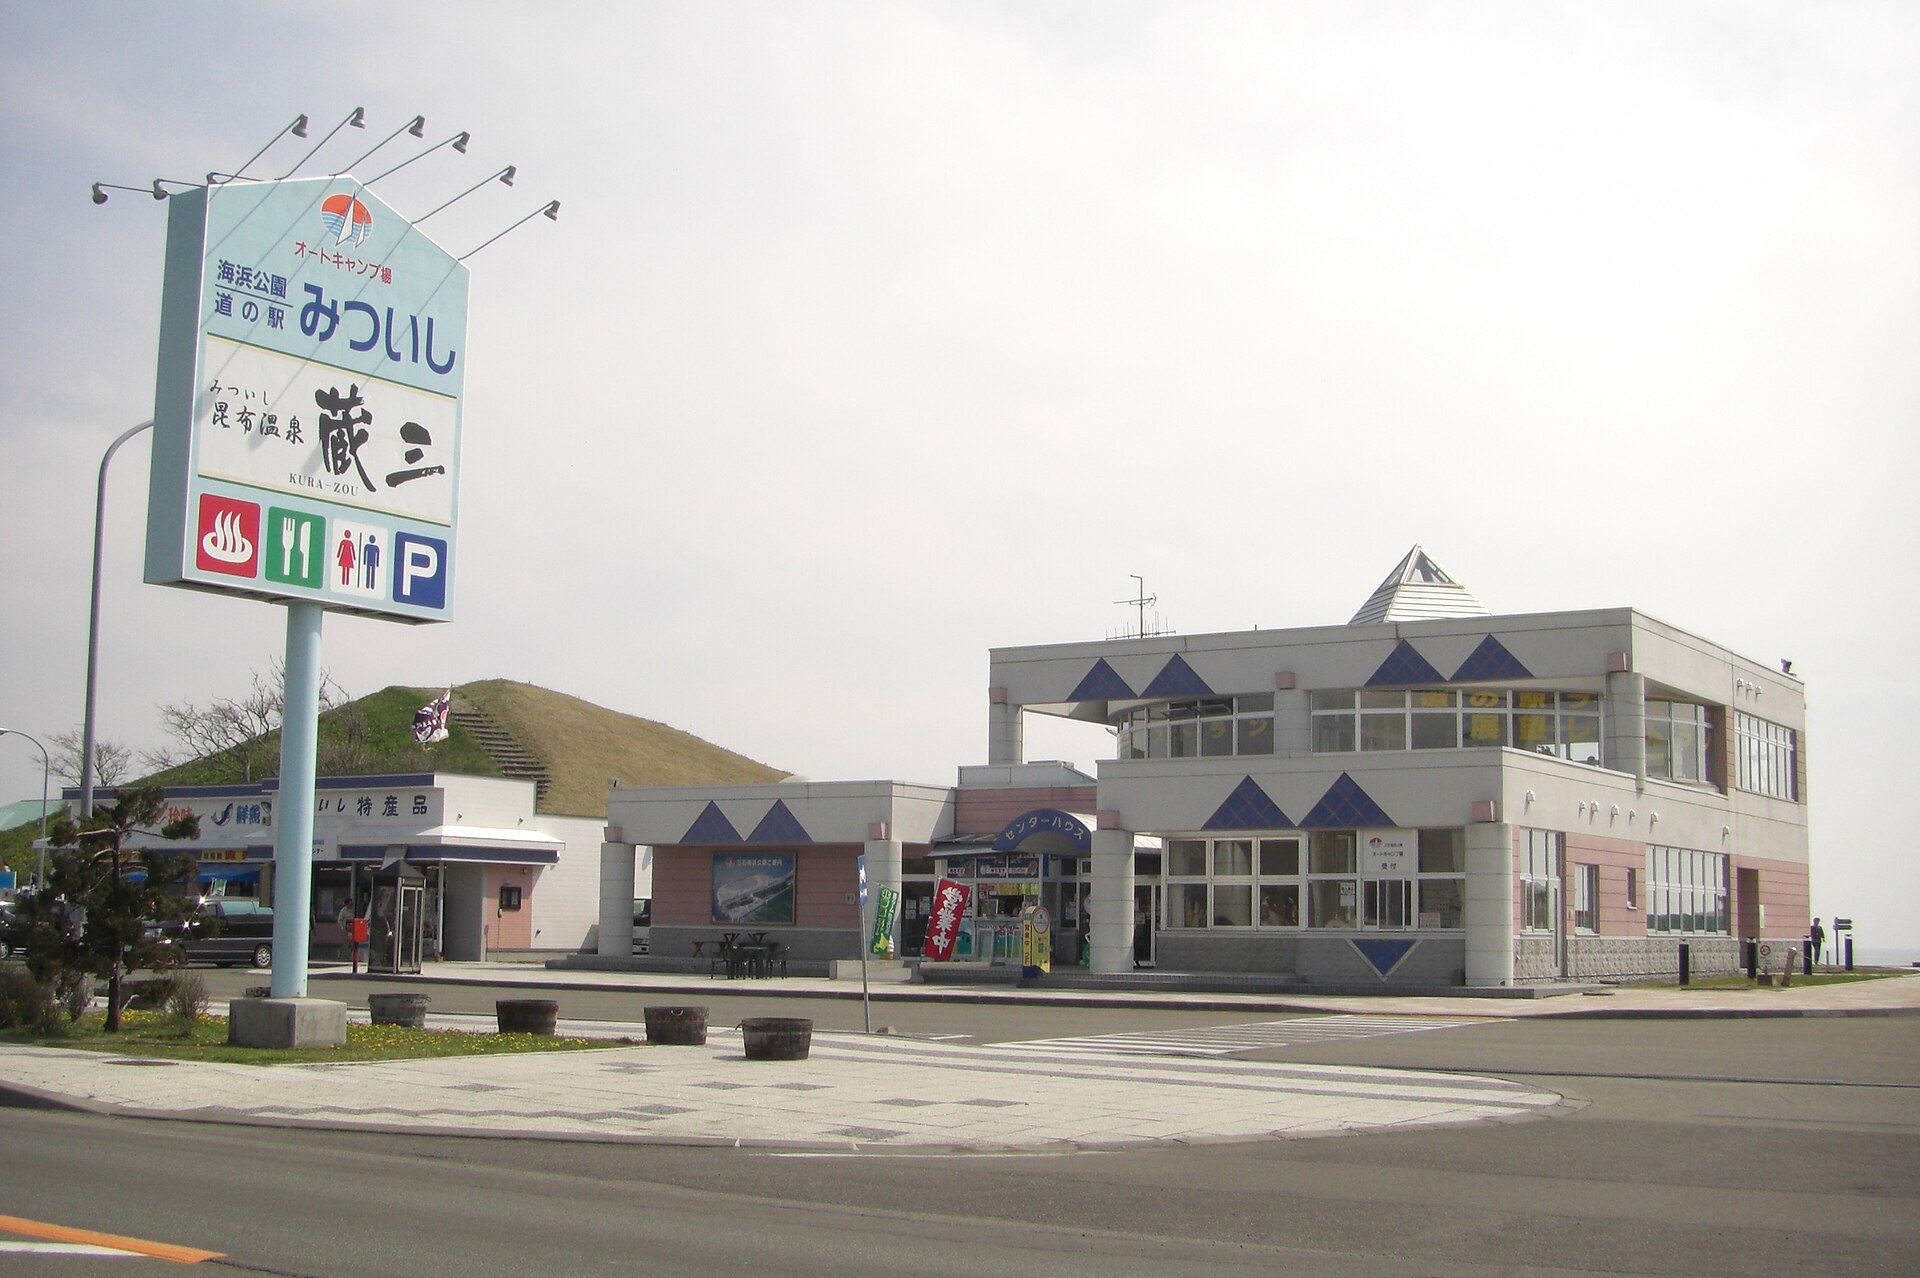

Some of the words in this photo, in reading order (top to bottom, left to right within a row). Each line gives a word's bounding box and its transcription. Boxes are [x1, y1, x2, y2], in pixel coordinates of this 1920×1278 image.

[217, 259, 288, 299] 海浜公園
[295, 241, 393, 285] オートキャンプ場
[214, 292, 285, 330] 道の駅
[300, 282, 456, 375] みついし
[210, 379, 269, 406] みついし
[211, 402, 305, 444] 昆布温泉
[315, 384, 445, 493] 蔵三
[289, 473, 359, 496] KURA-ZOU
[402, 541, 438, 596] P
[1005, 815, 1085, 840] センターハウス
[932, 886, 963, 955] 営業中
